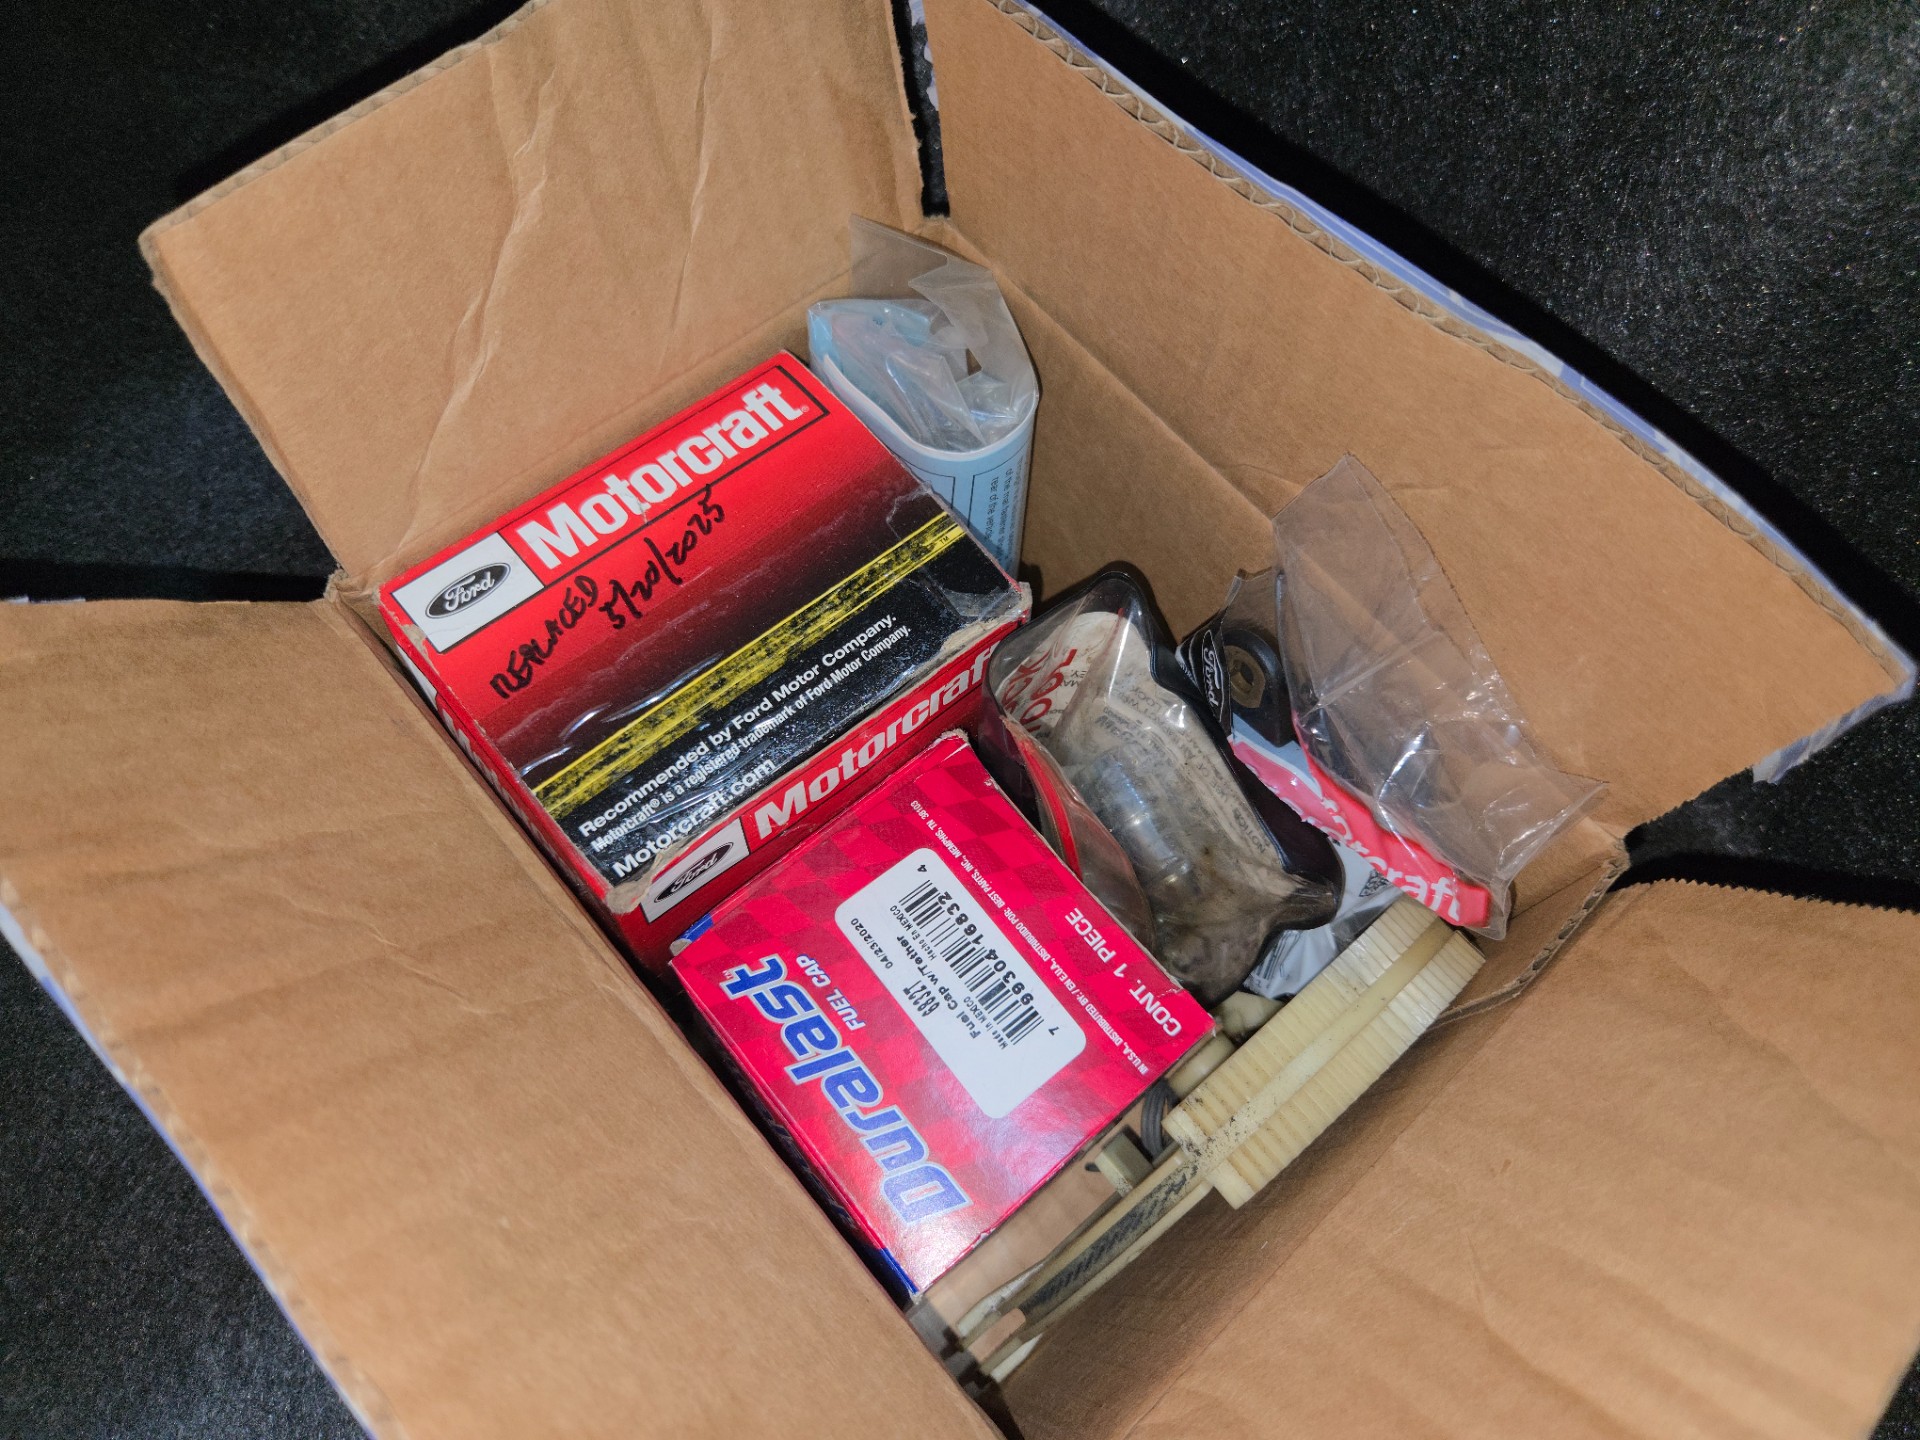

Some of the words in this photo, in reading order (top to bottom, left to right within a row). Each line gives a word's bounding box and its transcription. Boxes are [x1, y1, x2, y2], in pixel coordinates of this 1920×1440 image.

[599, 483, 725, 629] 5/20/2025
[444, 571, 495, 612] Ford
[1203, 647, 1221, 707] Ford
[579, 740, 709, 838] Recommended
[712, 725, 733, 745] by
[732, 697, 771, 729] Ford
[772, 663, 820, 702] Motor
[821, 613, 897, 669] Company.
[660, 789, 674, 803] is
[674, 785, 684, 795] a
[683, 744, 739, 789] registered
[738, 703, 794, 748] trademark
[793, 694, 807, 708] of
[805, 677, 832, 700] Ford
[830, 656, 862, 683] Motor
[861, 622, 911, 663] Company.
[671, 854, 718, 894] Ford
[754, 641, 1000, 840] Motorcraf
[613, 756, 775, 878] Motorcraft.com
[910, 799, 928, 819] 38103
[927, 819, 937, 829] TN
[934, 827, 961, 858] MEMPHIS,
[917, 864, 927, 873] 4
[970, 869, 991, 892] PARTS,
[988, 890, 1004, 908] BEST
[889, 904, 912, 930] MEXICO
[936, 891, 985, 946] 16832
[1003, 907, 1018, 924] POR:
[849, 917, 894, 968] 04/23/2020
[909, 929, 920, 939] En
[917, 938, 936, 960] Hecho
[1015, 922, 1050, 961] DISTRIBUIDO
[1066, 907, 1115, 962] PIECE
[796, 954, 831, 988] CAP
[894, 933, 939, 985] w/Tether
[1114, 962, 1128, 979] 1
[983, 948, 1034, 1005] 99304
[1064, 979, 1075, 990] EN
[826, 988, 866, 1031] FUEL
[903, 978, 939, 1016] 6832T
[936, 985, 960, 1010] Cap
[962, 995, 987, 1022] MEXICO
[1075, 992, 1088, 1005] BY:
[1128, 978, 1181, 1037] CONT.
[956, 1011, 981, 1038] Fuel
[990, 1029, 1008, 1048] Made
[1048, 1026, 1060, 1036] 7
[1085, 1003, 1122, 1045] DISTRIBUTED
[1137, 1064, 1147, 1074] IN
[719, 953, 974, 1226] Duralast
